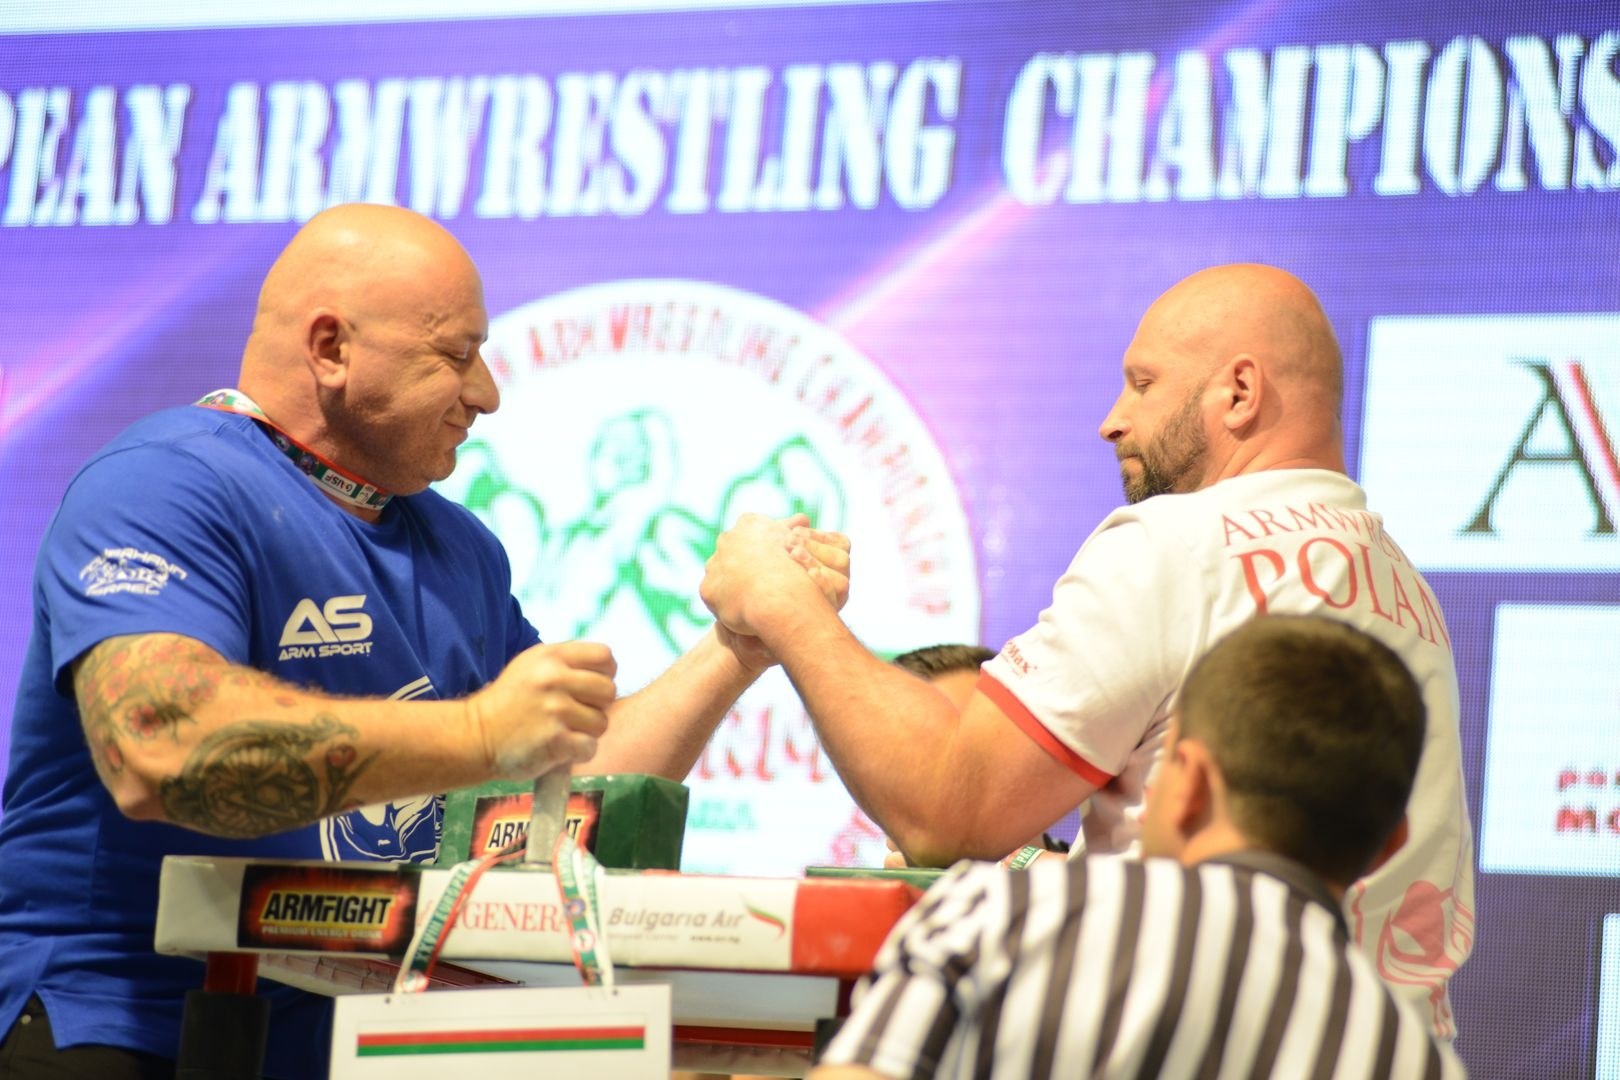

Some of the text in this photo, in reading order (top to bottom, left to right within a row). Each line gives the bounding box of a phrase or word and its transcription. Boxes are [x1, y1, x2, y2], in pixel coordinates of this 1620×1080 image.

[192, 57, 962, 224] ARMWRESTLING
[279, 594, 373, 647] AS
[279, 642, 373, 661] ARM SPORT
[263, 892, 392, 924] ARMFIGHT
[607, 907, 744, 931] Bulgaria Air
